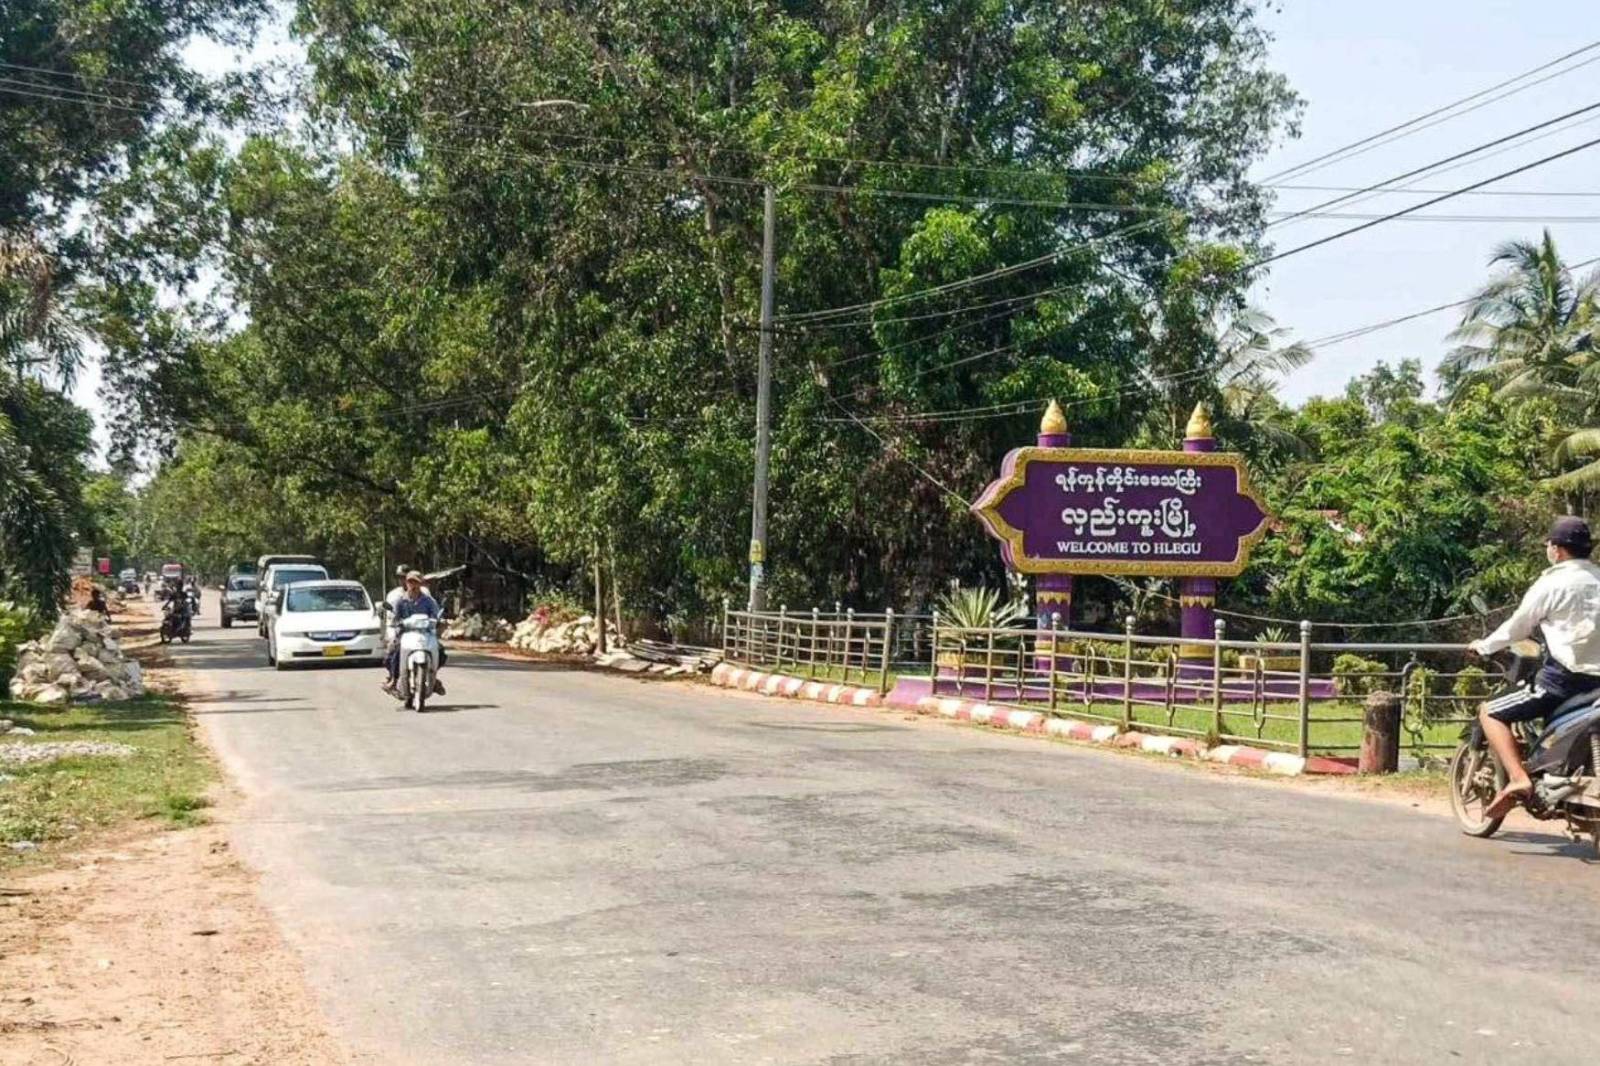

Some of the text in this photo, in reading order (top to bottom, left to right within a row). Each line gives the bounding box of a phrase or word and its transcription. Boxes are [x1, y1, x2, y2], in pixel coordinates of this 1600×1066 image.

[1056, 541, 1202, 555] WELCOME TO HLEGU
